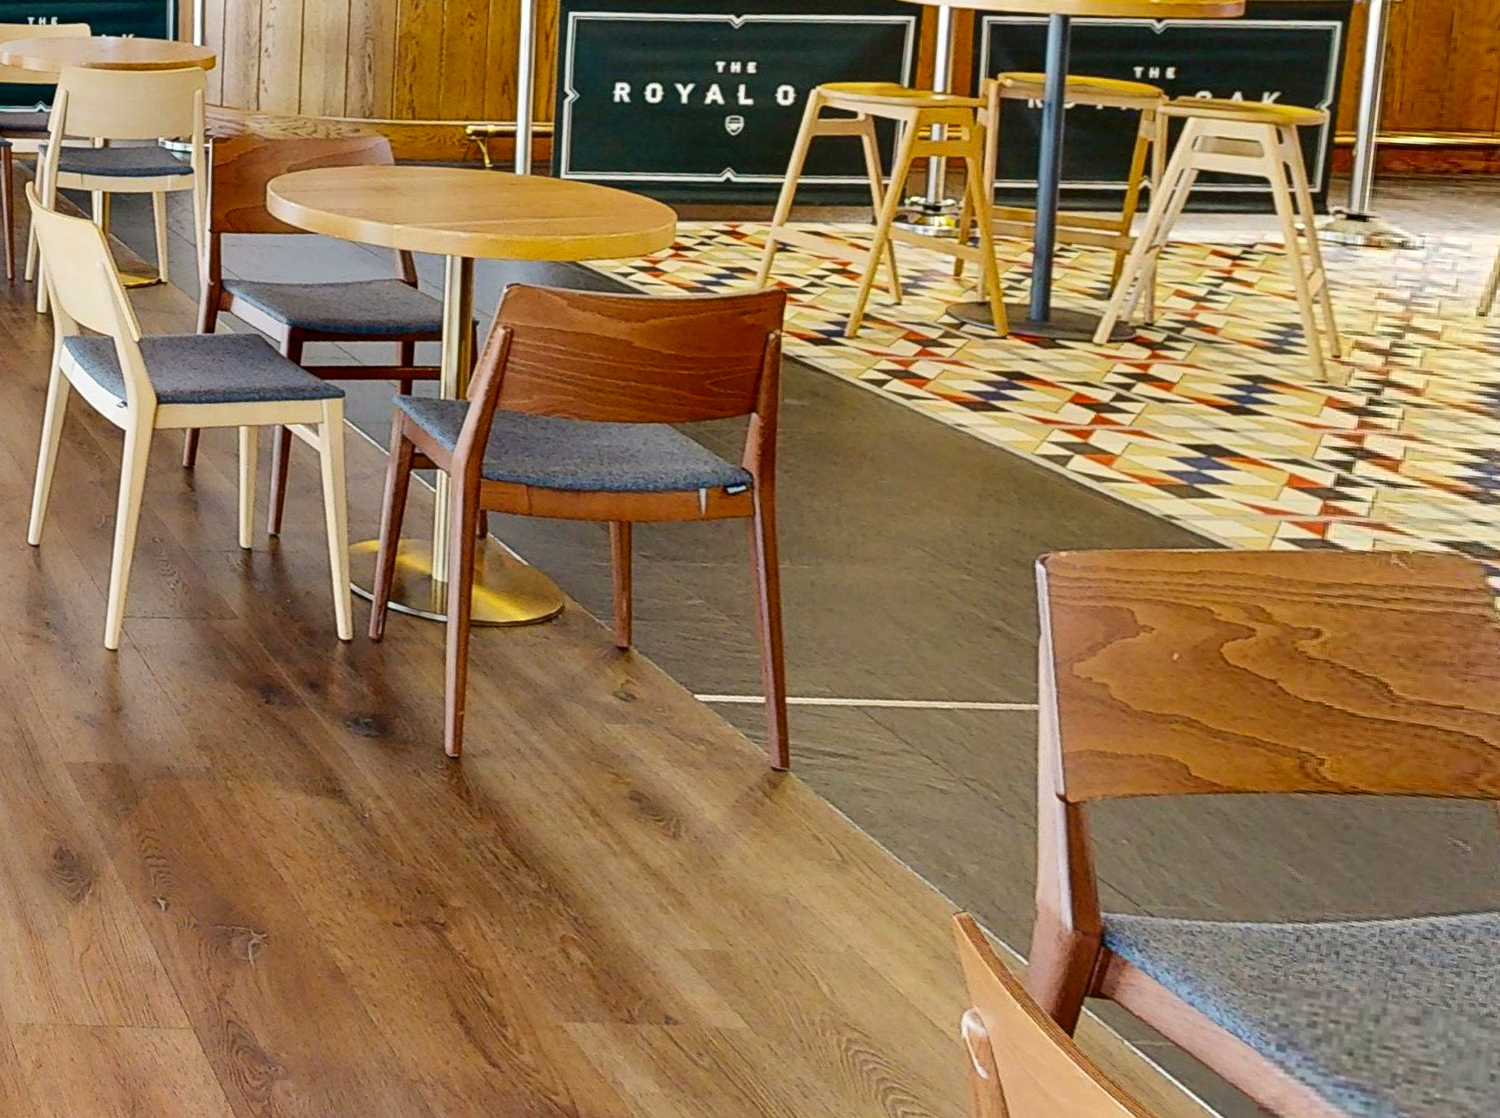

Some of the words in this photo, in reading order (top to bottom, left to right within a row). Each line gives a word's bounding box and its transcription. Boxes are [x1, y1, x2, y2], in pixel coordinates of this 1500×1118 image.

[27, 17, 58, 26] THE
[715, 61, 758, 74] THE
[1133, 66, 1177, 80] THE
[612, 82, 755, 105] ROYAL
